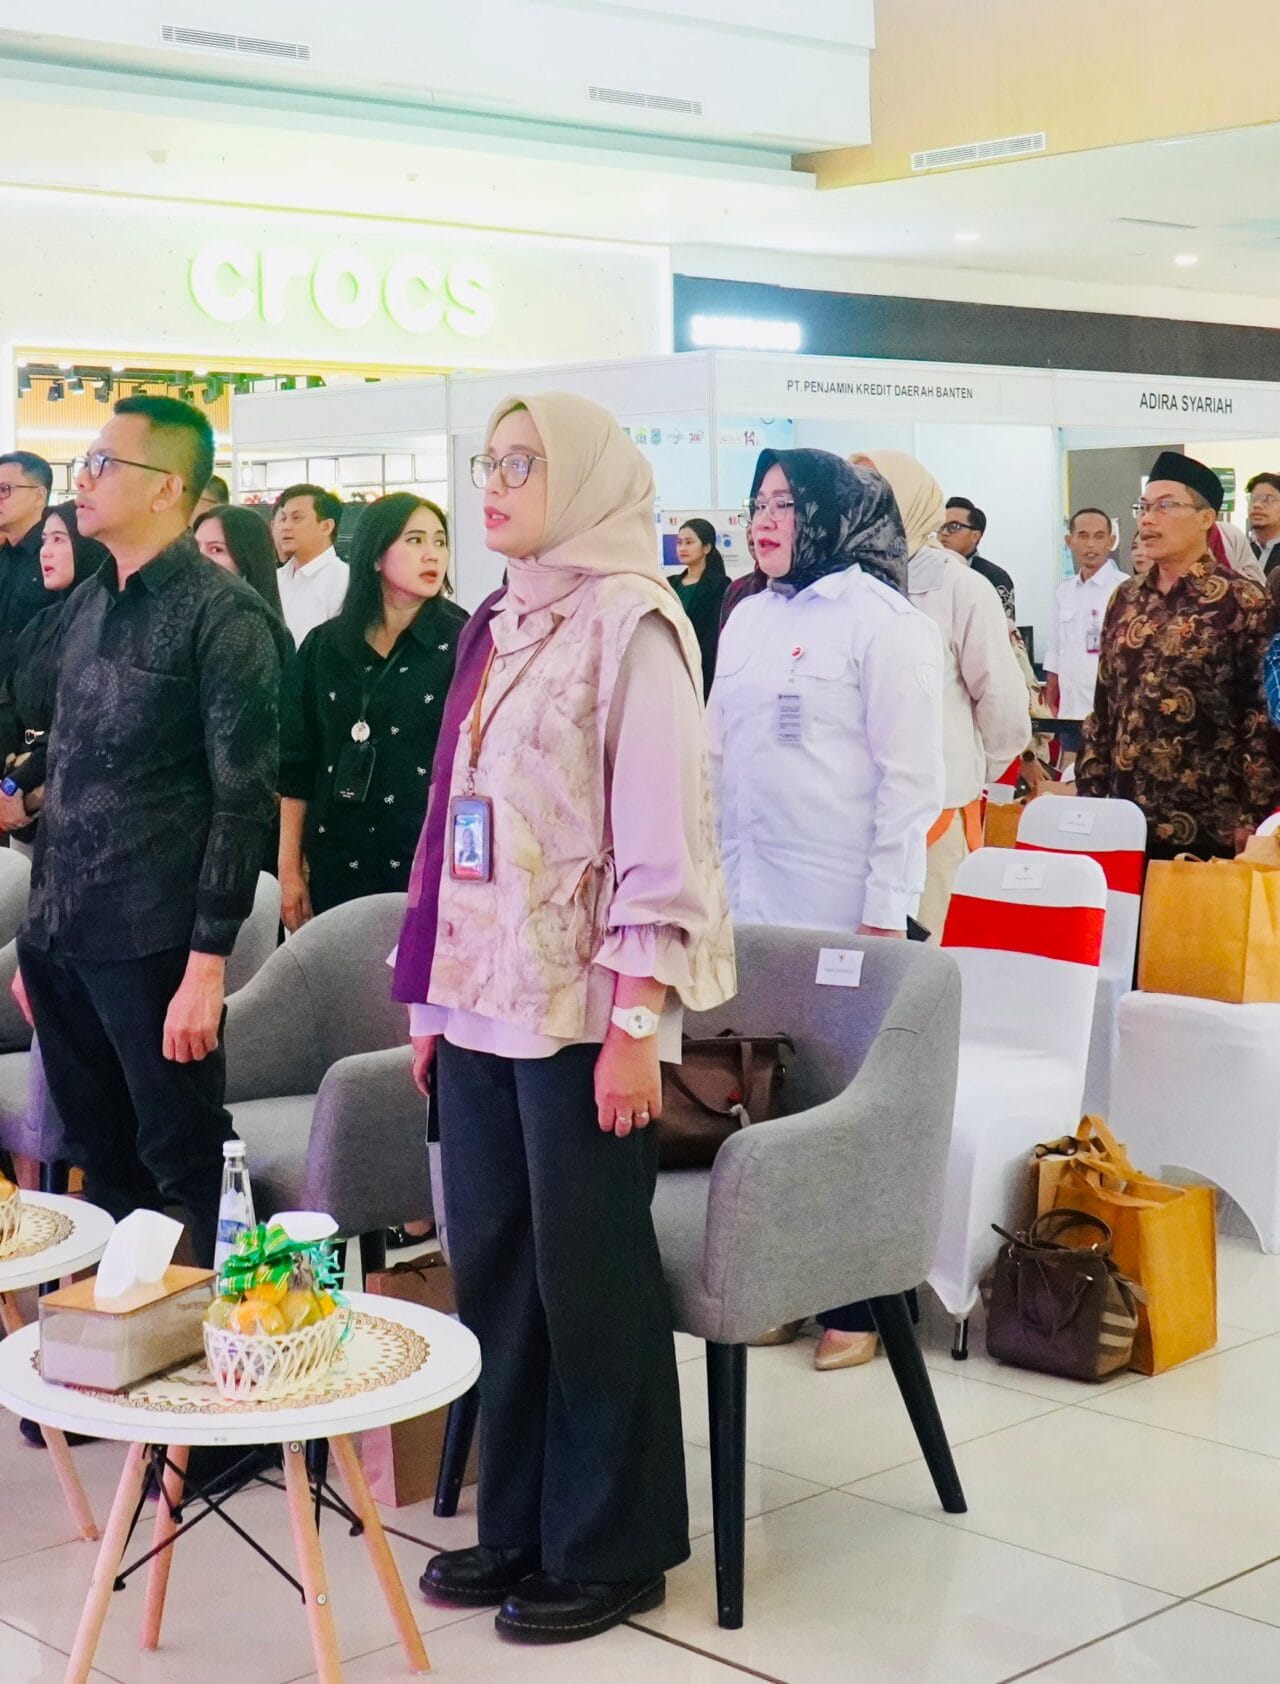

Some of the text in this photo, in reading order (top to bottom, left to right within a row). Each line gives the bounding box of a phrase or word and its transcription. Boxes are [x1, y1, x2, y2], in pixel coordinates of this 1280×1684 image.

[188, 240, 496, 338] crocs
[787, 379, 973, 399] PT. PENJAMIN KREDIT DAERAH BANTEN
[1140, 392, 1233, 414] ADIRA SYARIAH
